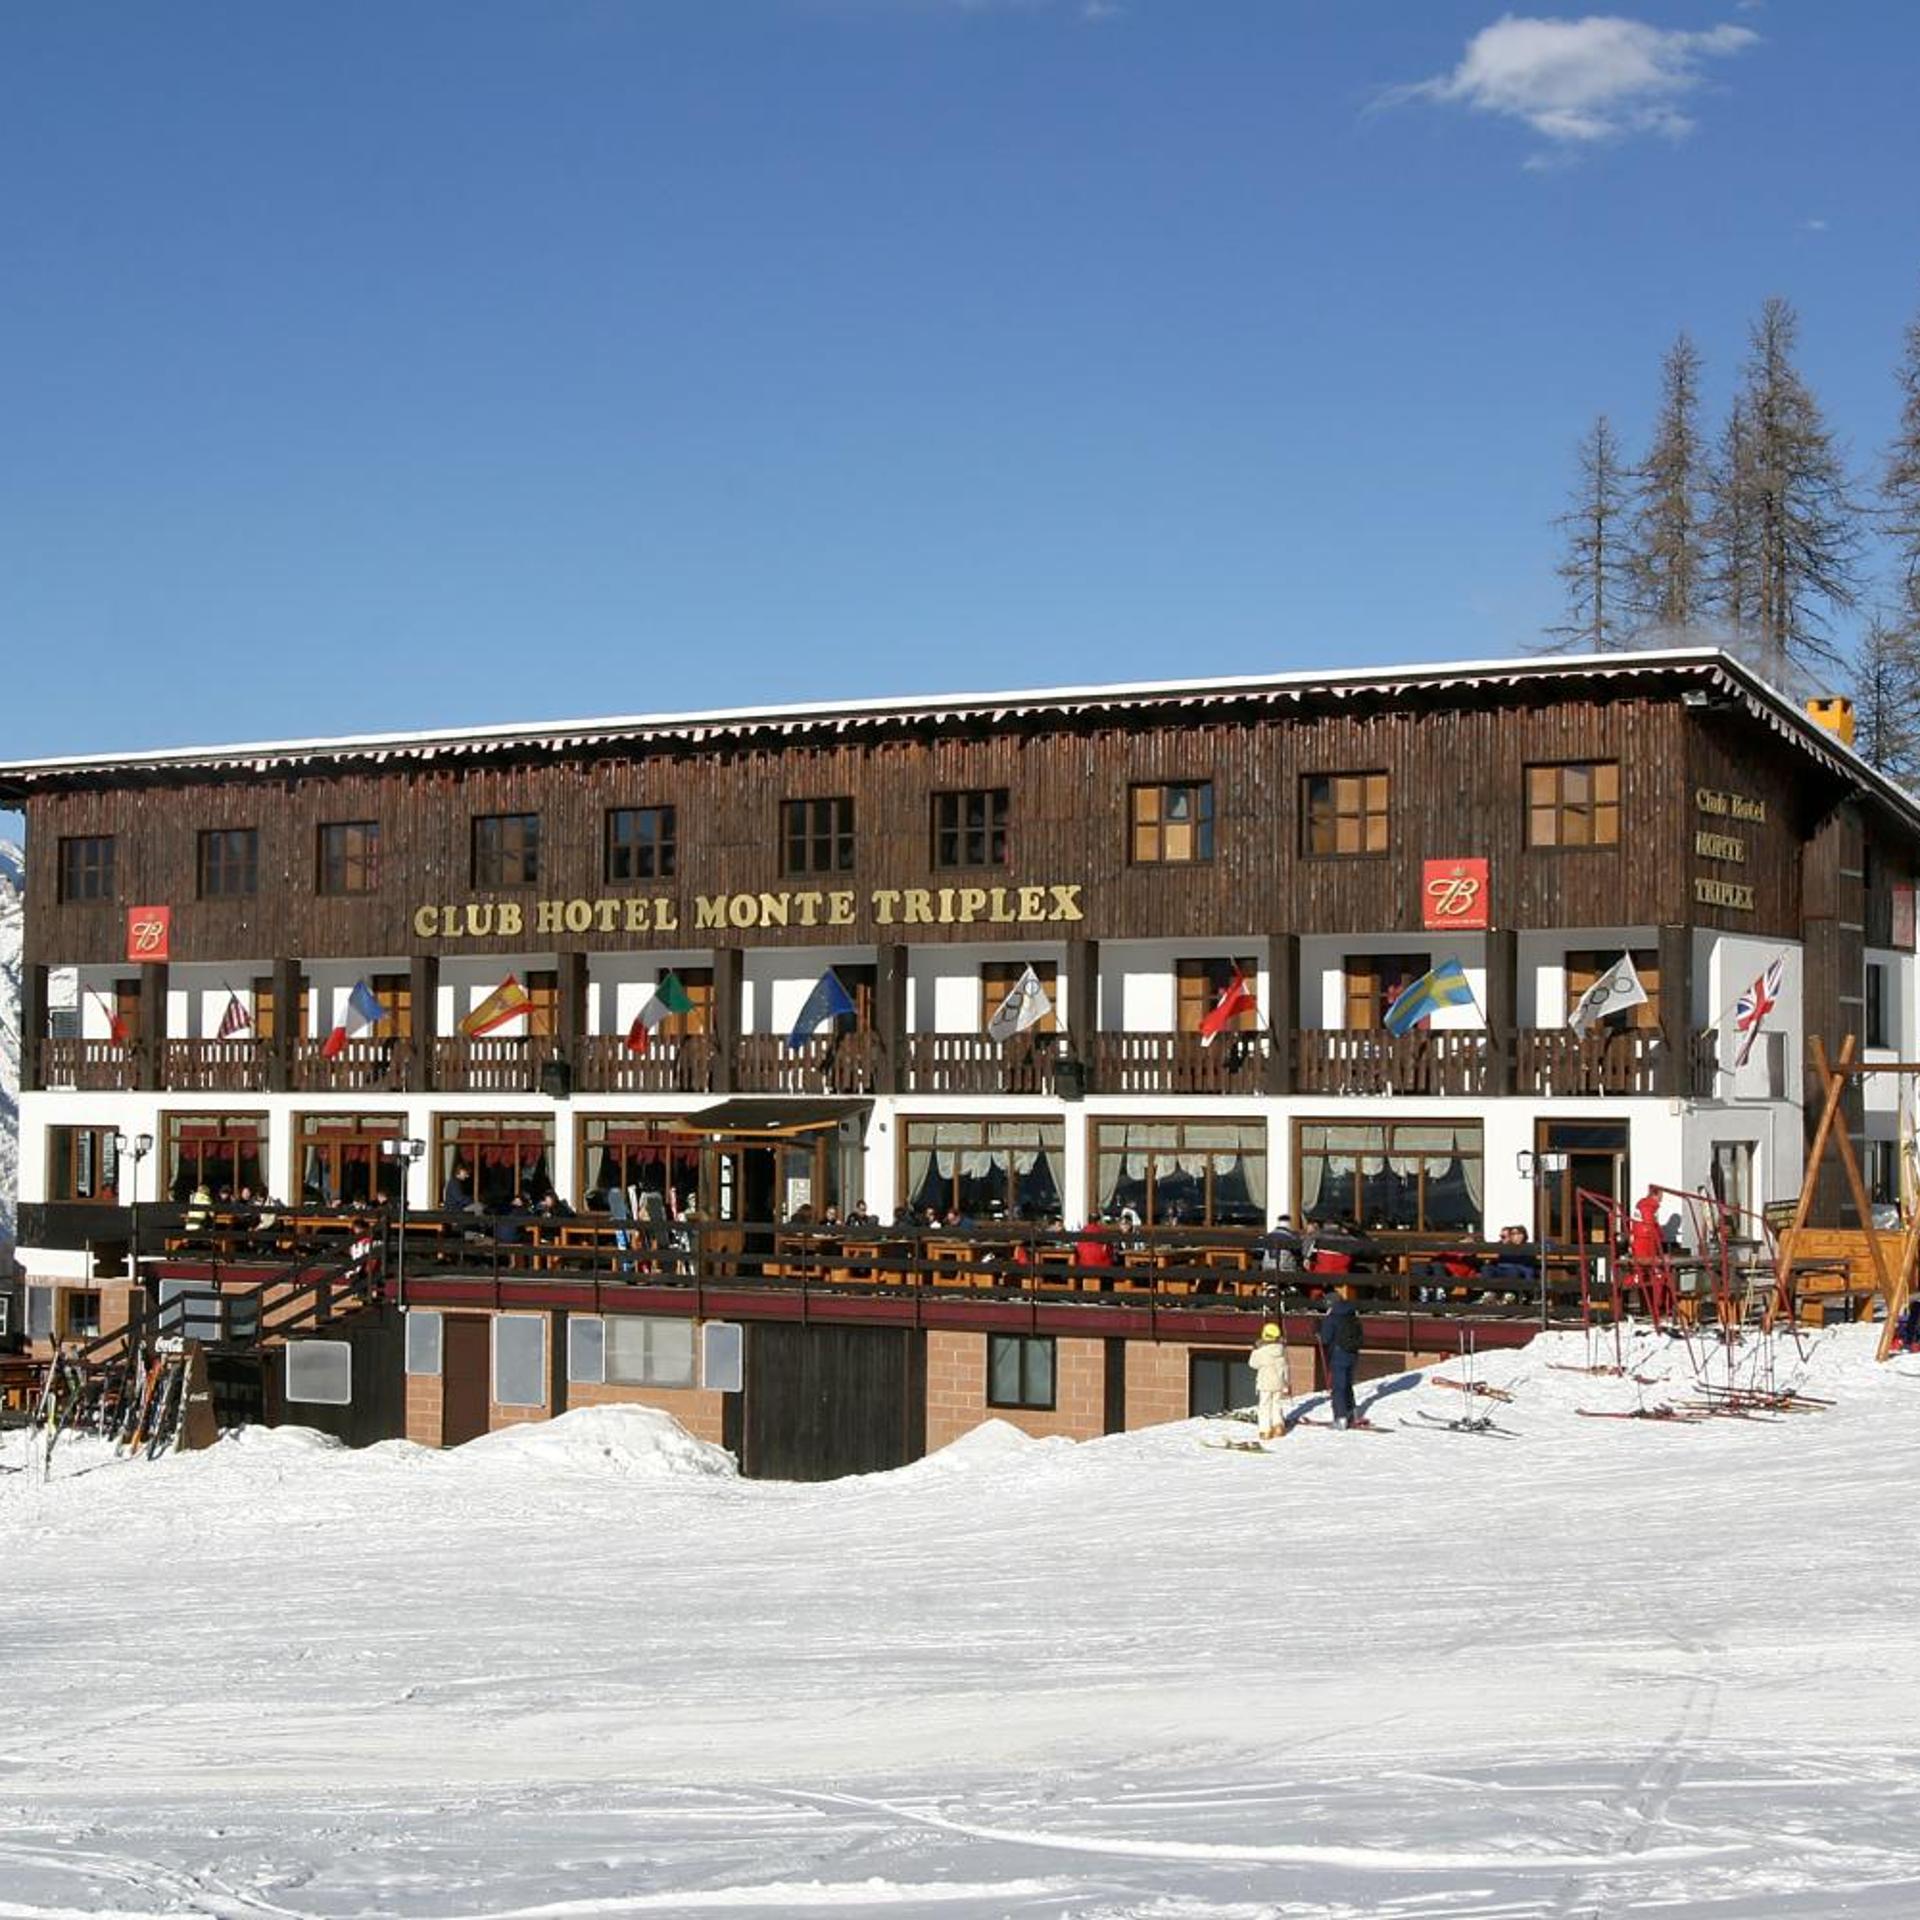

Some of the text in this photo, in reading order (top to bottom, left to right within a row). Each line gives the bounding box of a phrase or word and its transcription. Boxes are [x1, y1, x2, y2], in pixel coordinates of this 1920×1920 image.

[414, 884, 1084, 937] CLUB HOTEL MONTE TRIPLEX
